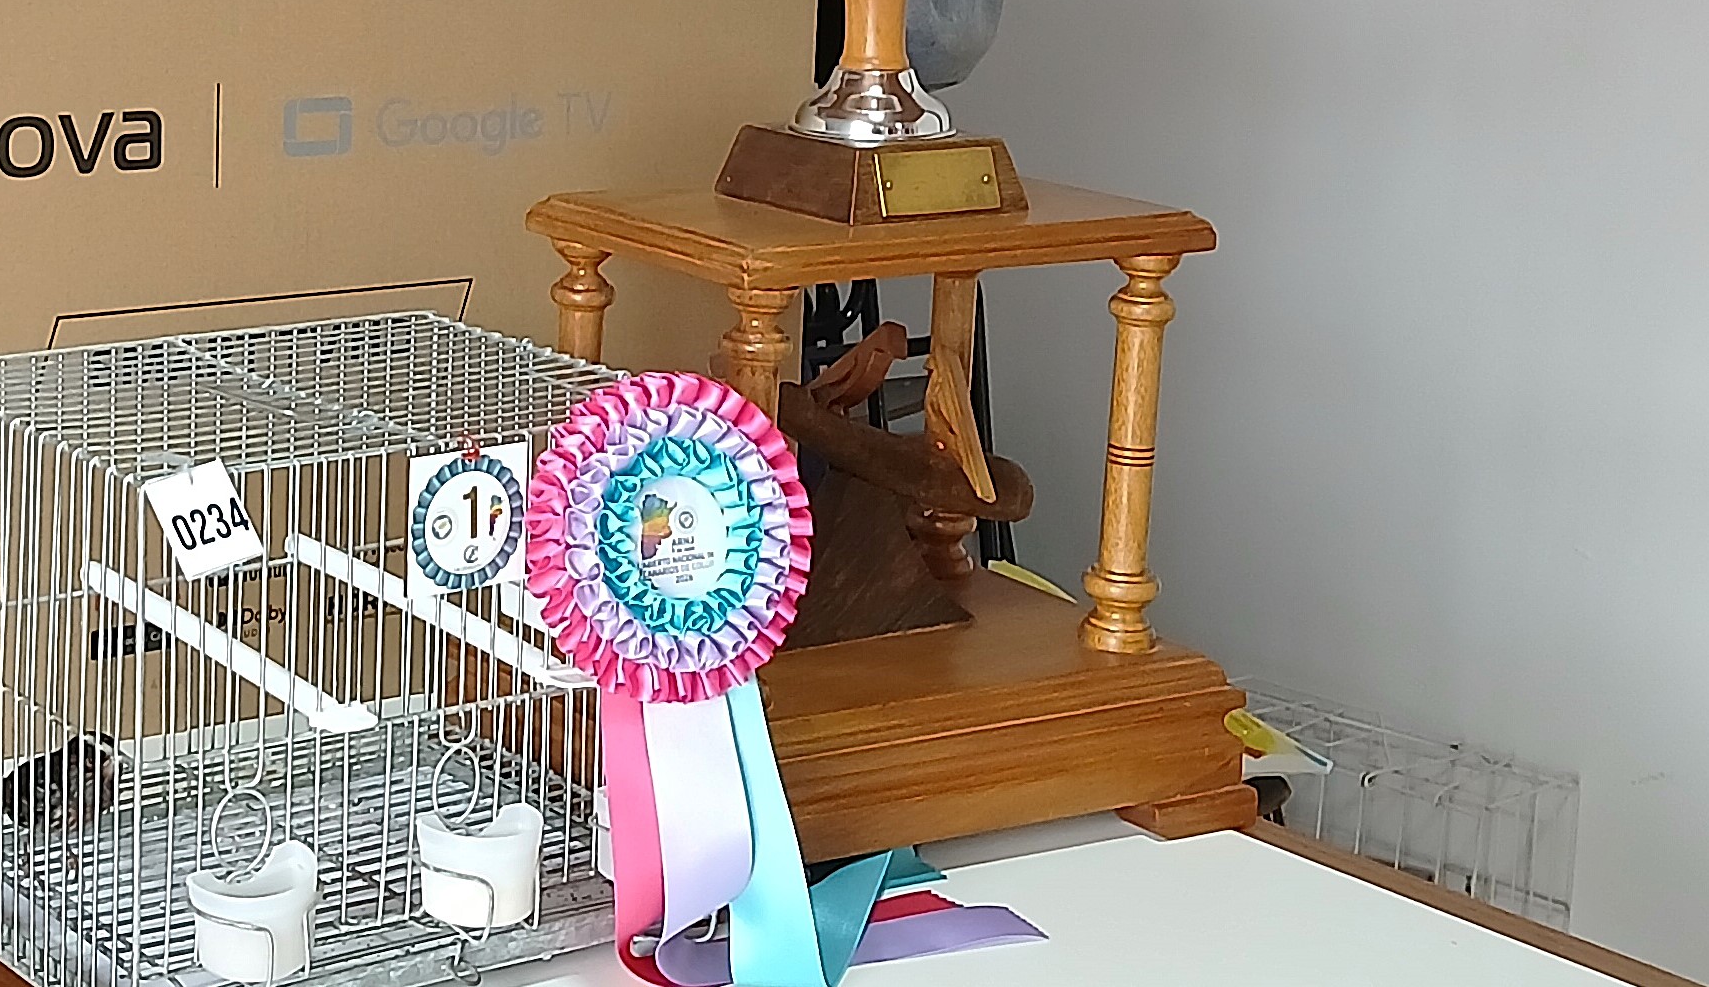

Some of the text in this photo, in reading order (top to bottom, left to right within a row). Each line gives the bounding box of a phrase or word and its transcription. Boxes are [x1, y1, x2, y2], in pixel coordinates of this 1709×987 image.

[377, 91, 612, 156] Google TV
[172, 497, 249, 550] 0234
[463, 485, 478, 539] 1
